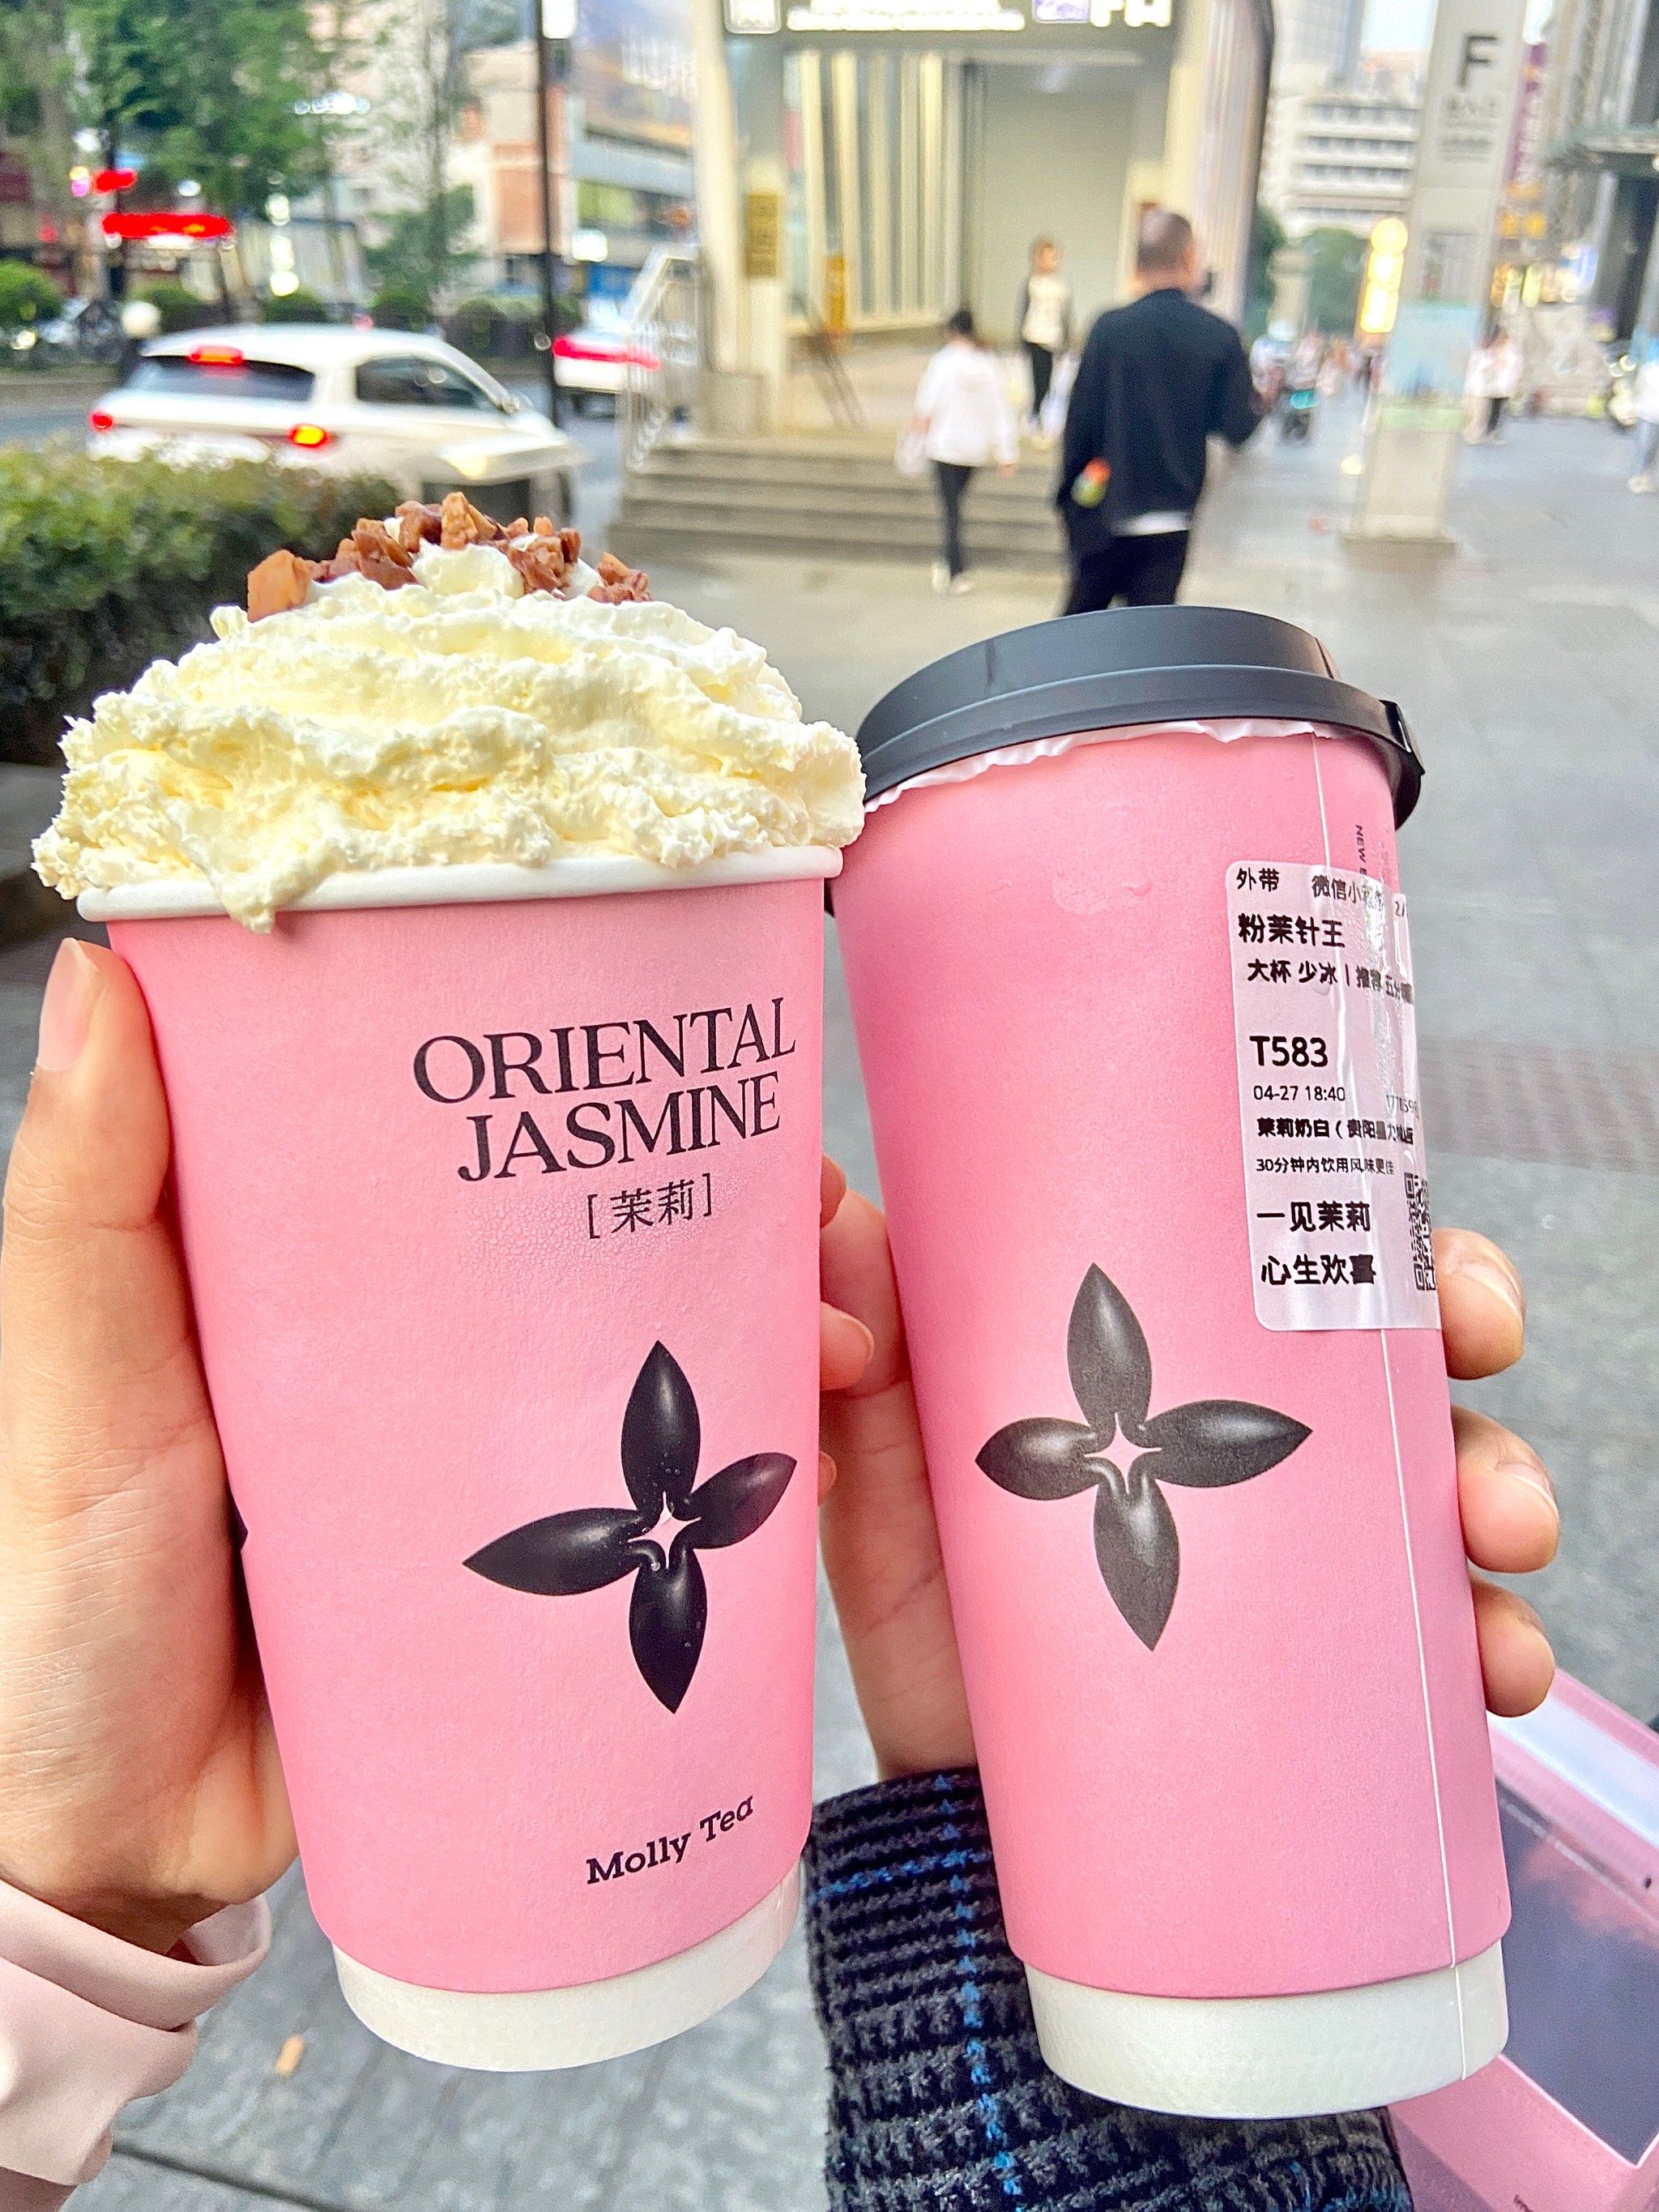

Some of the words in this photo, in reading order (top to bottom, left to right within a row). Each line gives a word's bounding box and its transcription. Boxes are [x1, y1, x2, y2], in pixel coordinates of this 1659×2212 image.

[1457, 32, 1499, 89] F
[1355, 825, 1366, 864] NEW
[1236, 868, 1280, 892] 外带
[1238, 913, 1345, 948] 粉茉针王
[413, 997, 796, 1104] ORIENTAL
[1249, 1036, 1328, 1067] T583
[1253, 1086, 1299, 1101] 04-27
[1306, 1086, 1346, 1101] 18:40
[457, 1071, 780, 1181] JASMINE
[1256, 1201, 1371, 1232] 一见茉莉
[586, 1832, 691, 1885] Molly
[699, 1794, 753, 1843] Tea
